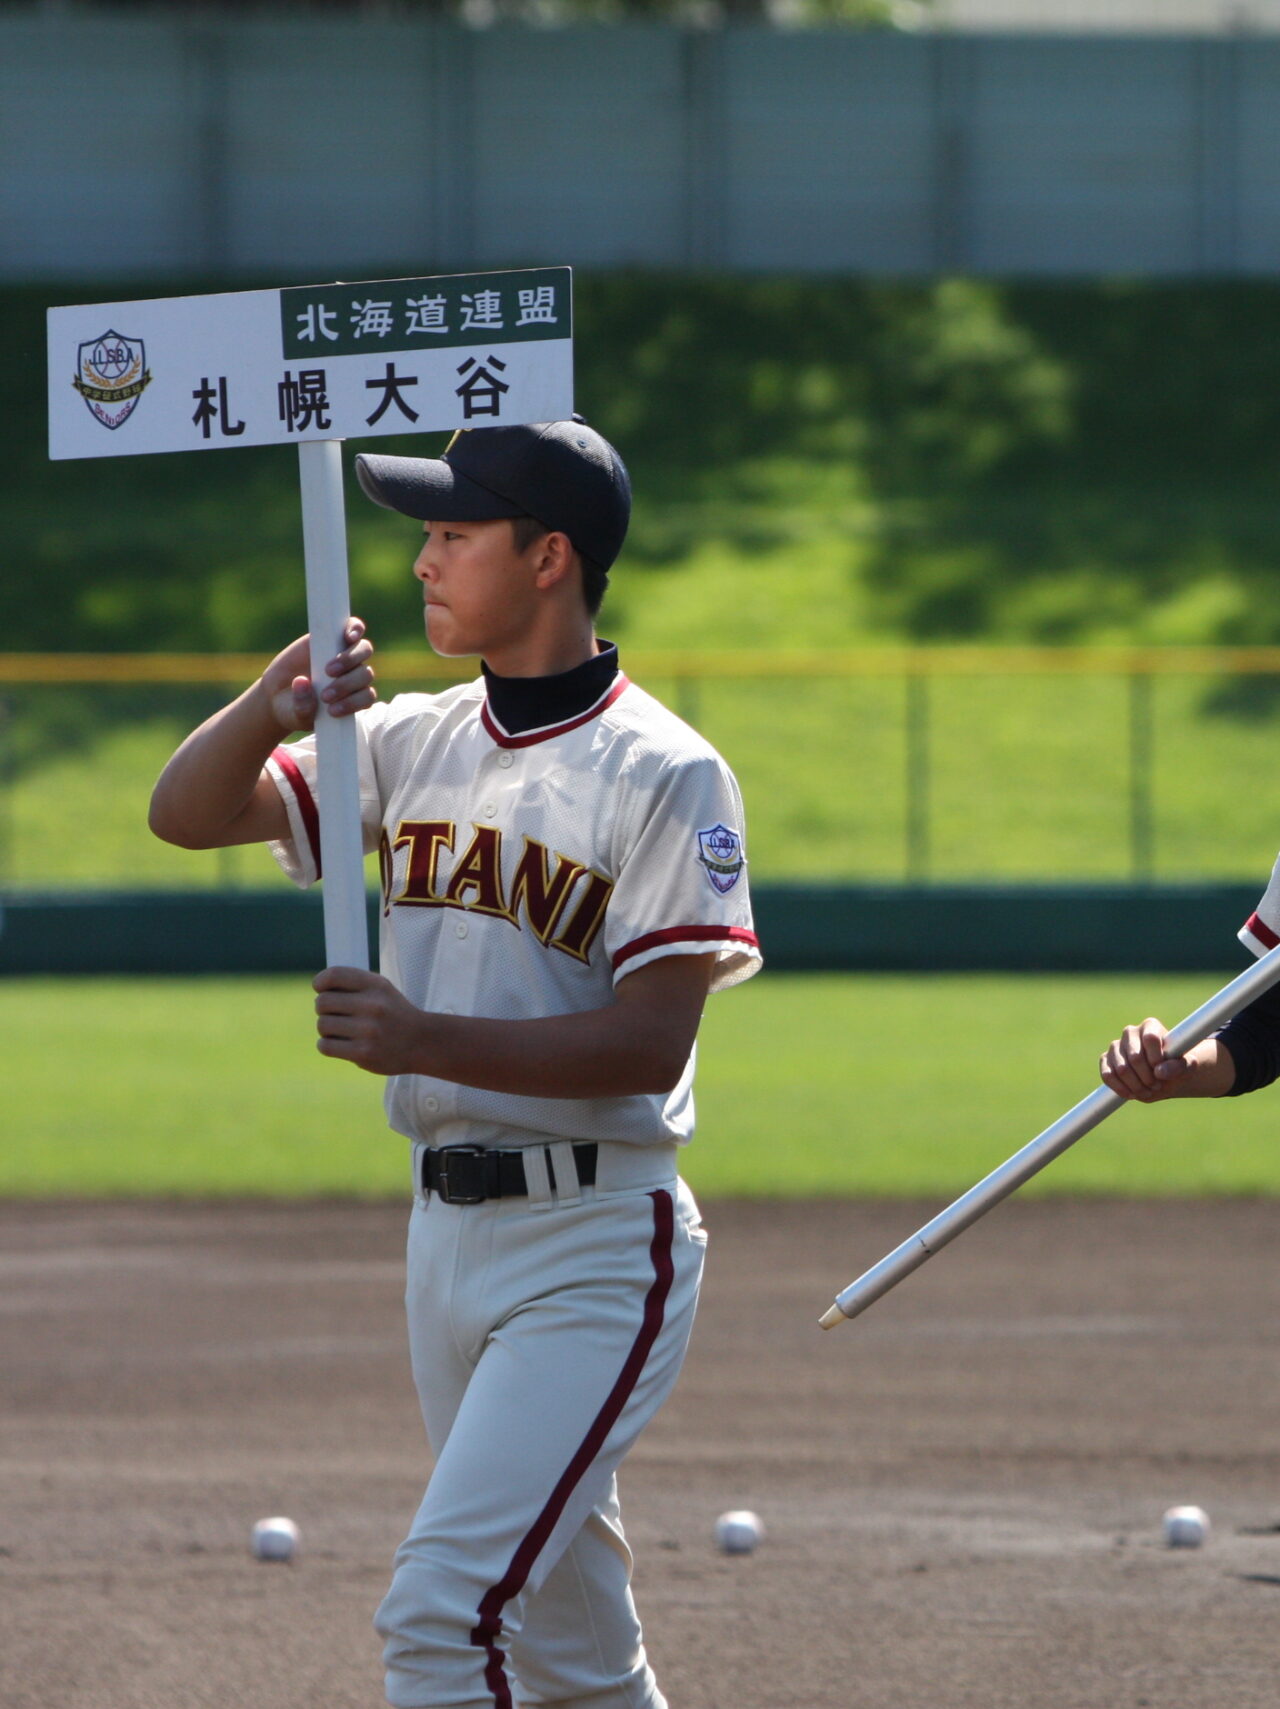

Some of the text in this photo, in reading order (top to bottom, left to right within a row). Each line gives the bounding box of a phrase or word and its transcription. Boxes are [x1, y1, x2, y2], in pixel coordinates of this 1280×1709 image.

[296, 285, 559, 343] 北海道連盟
[191, 354, 510, 439] 札幌大谷
